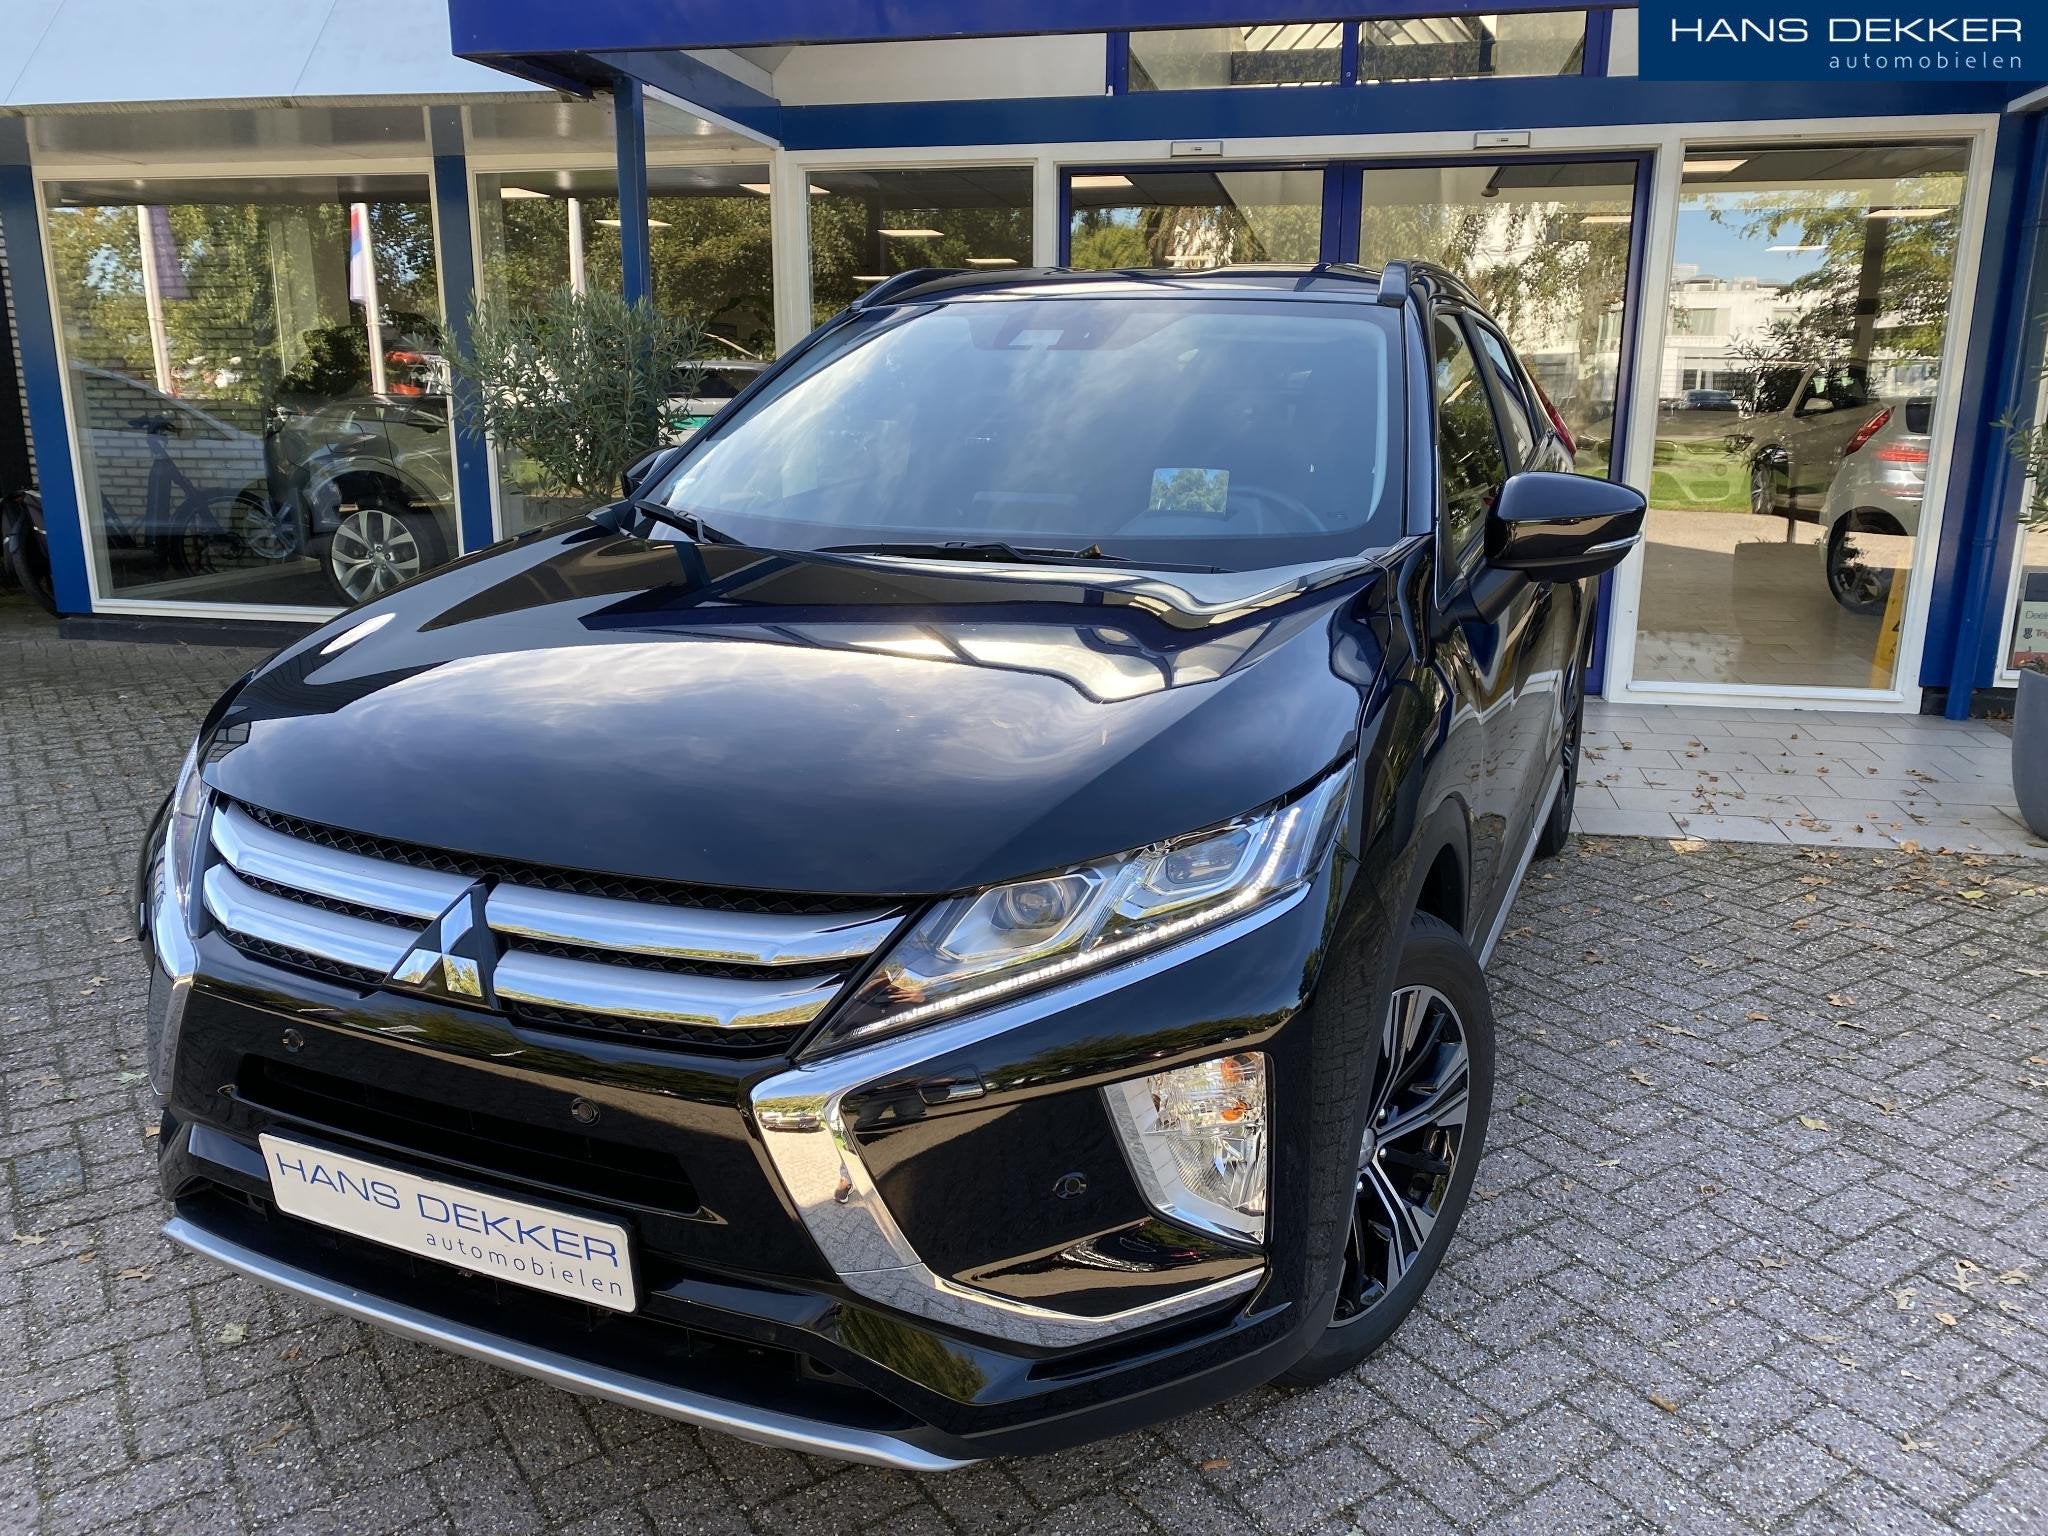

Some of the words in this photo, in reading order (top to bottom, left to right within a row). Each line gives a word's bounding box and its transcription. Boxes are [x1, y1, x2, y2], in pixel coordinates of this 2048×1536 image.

[276, 1152, 401, 1210] HANS
[416, 1193, 618, 1268] DEKKER
[426, 1233, 622, 1296] automobielen
